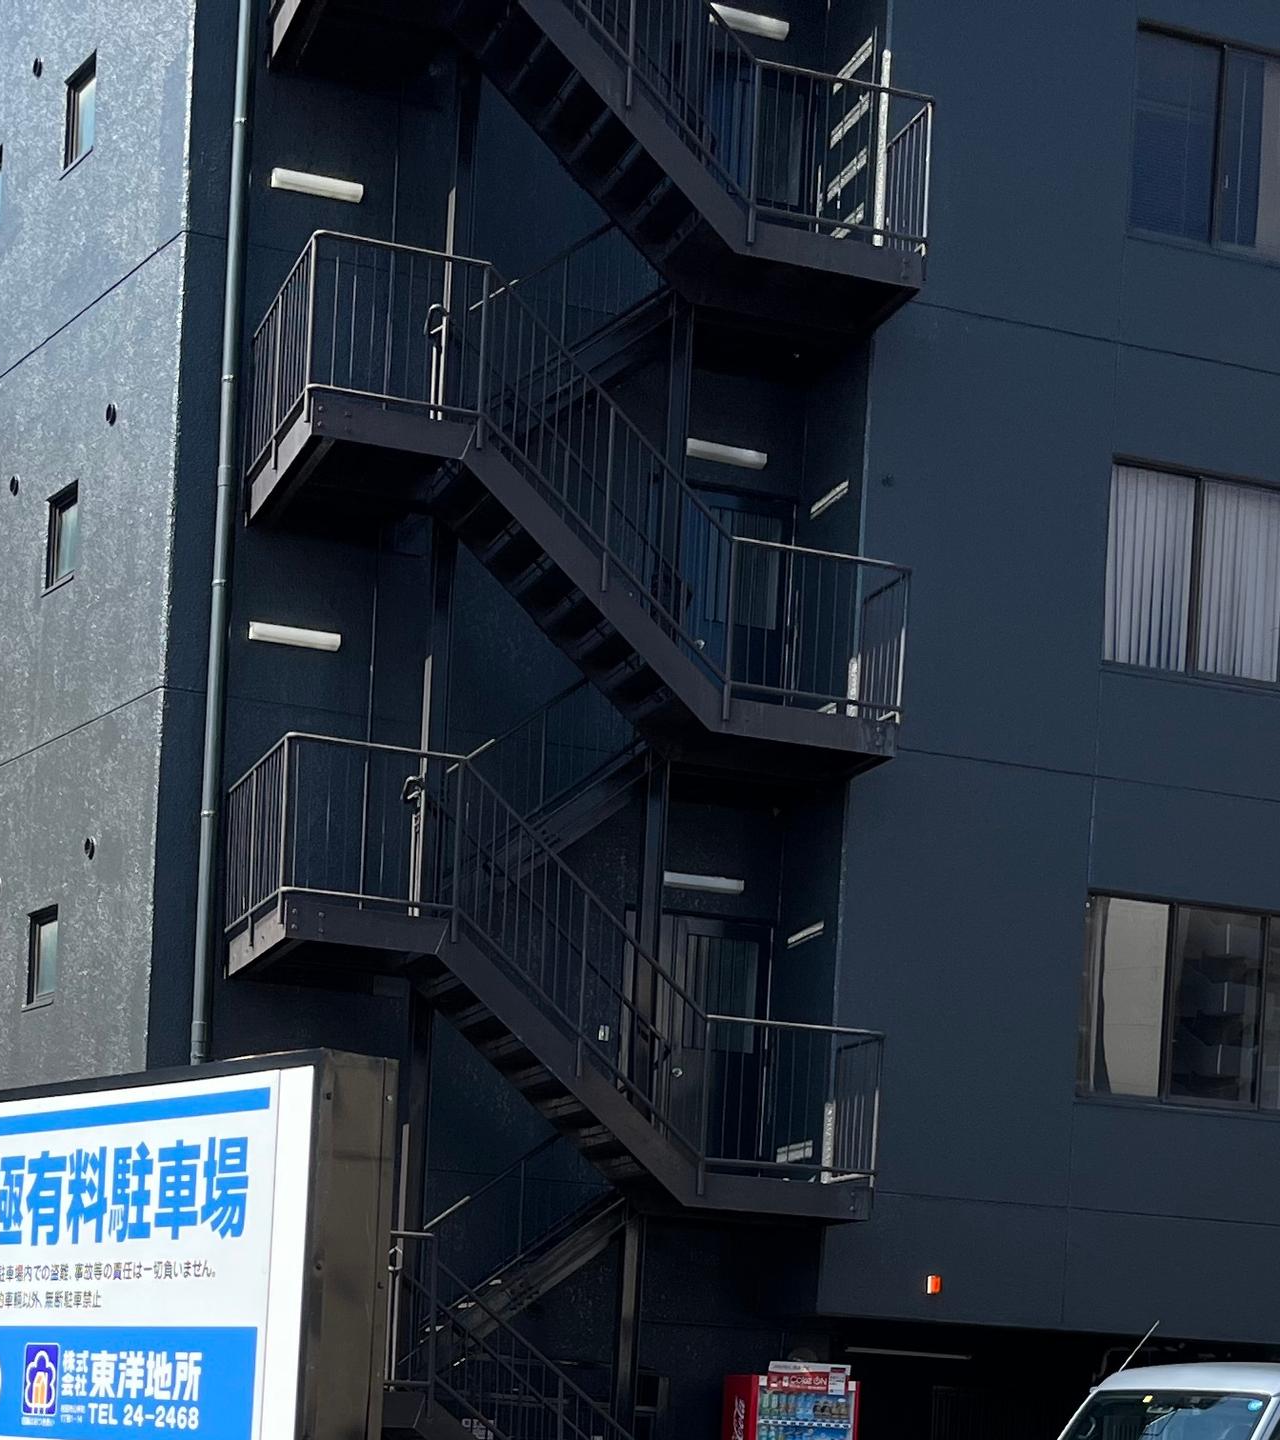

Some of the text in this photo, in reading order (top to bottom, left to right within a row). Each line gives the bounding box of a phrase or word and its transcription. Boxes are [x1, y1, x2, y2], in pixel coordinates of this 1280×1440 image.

[62, 1350, 89, 1374] 株式
[61, 1374, 88, 1397] 会社
[89, 1350, 203, 1401] 東洋地所
[88, 1402, 200, 1430] TEL 24-2468
